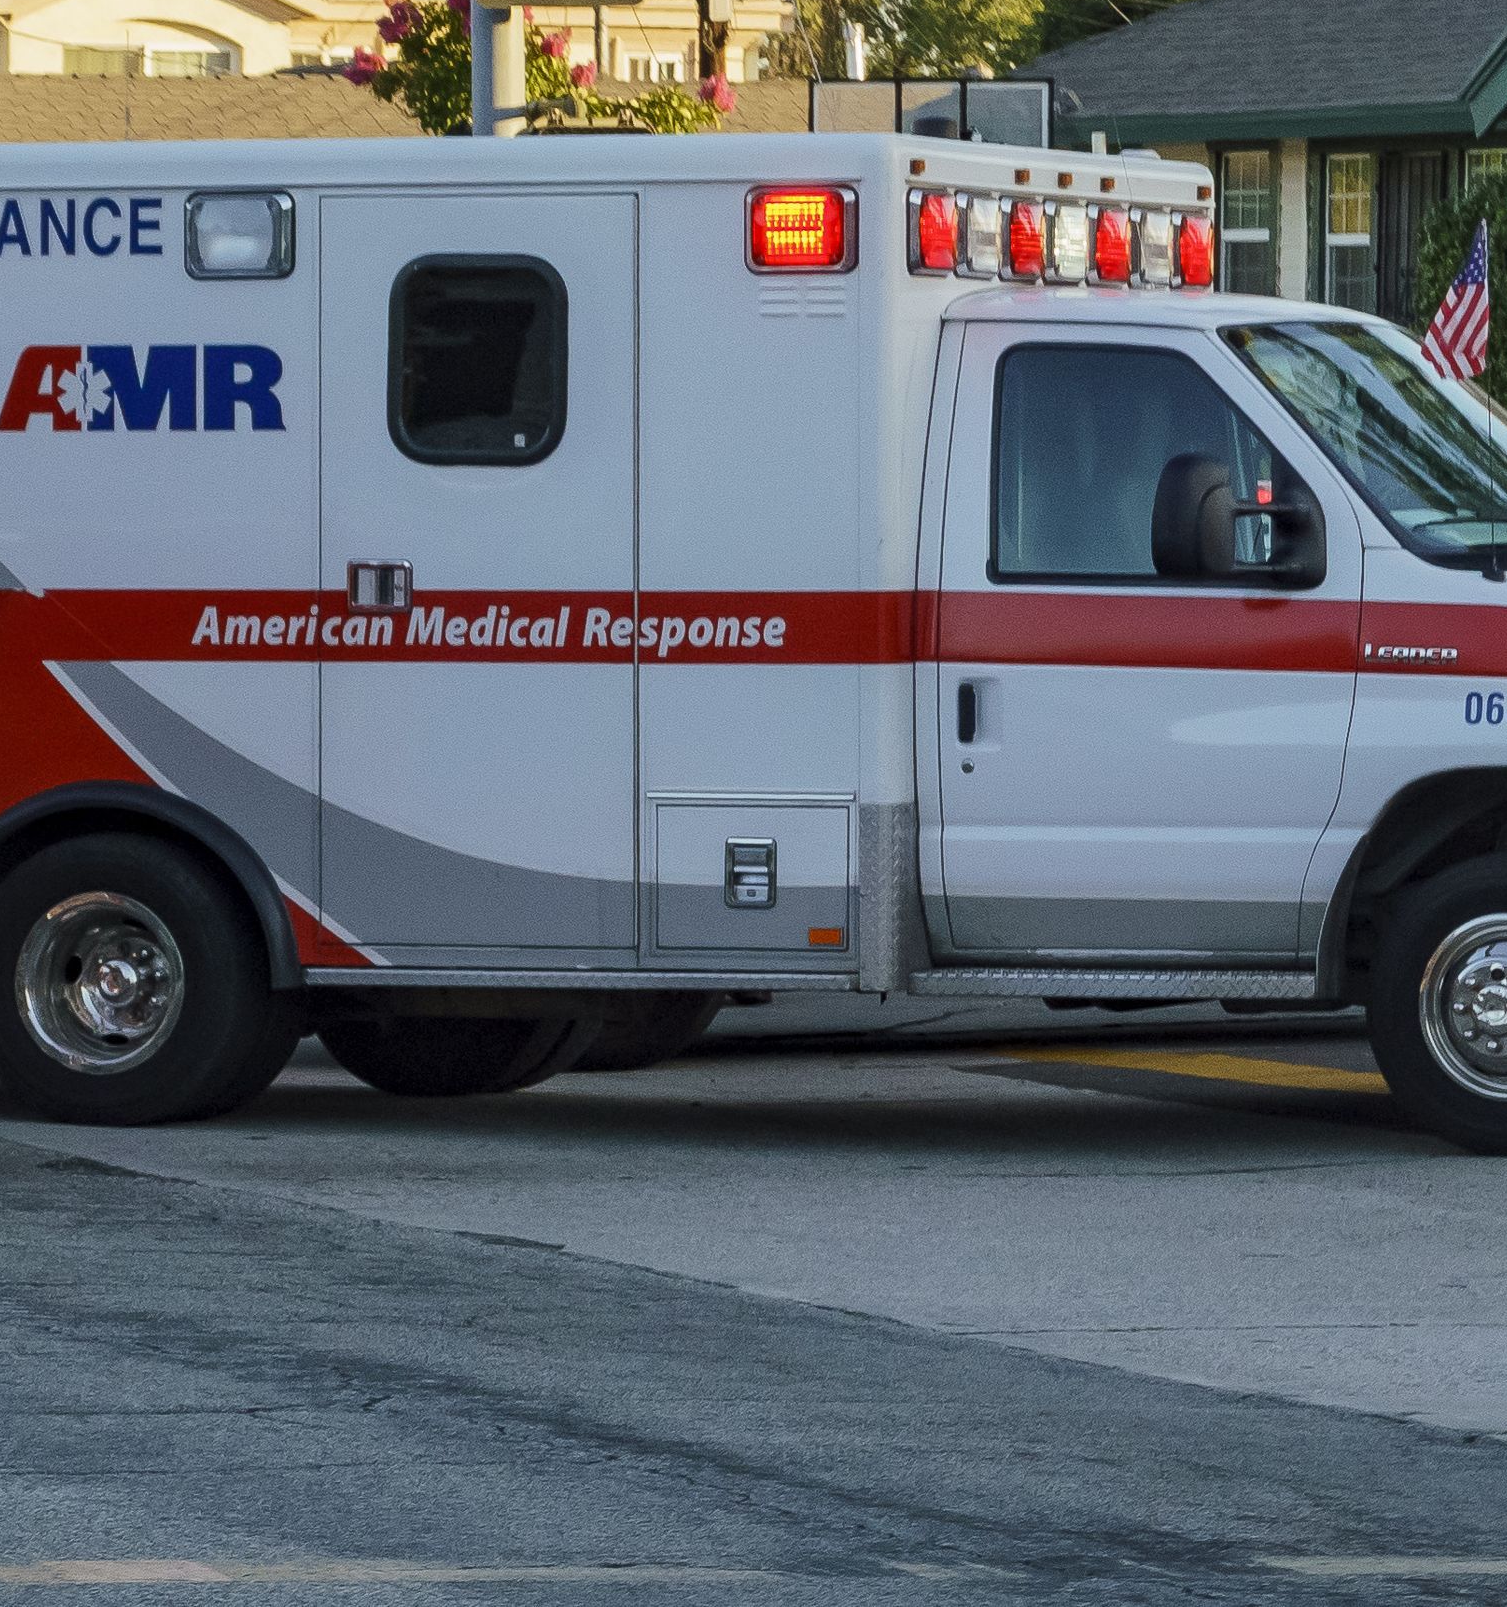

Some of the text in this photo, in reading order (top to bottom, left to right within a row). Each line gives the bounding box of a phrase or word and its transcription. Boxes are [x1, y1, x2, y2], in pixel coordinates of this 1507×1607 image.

[192, 604, 787, 658] American Medical Response
